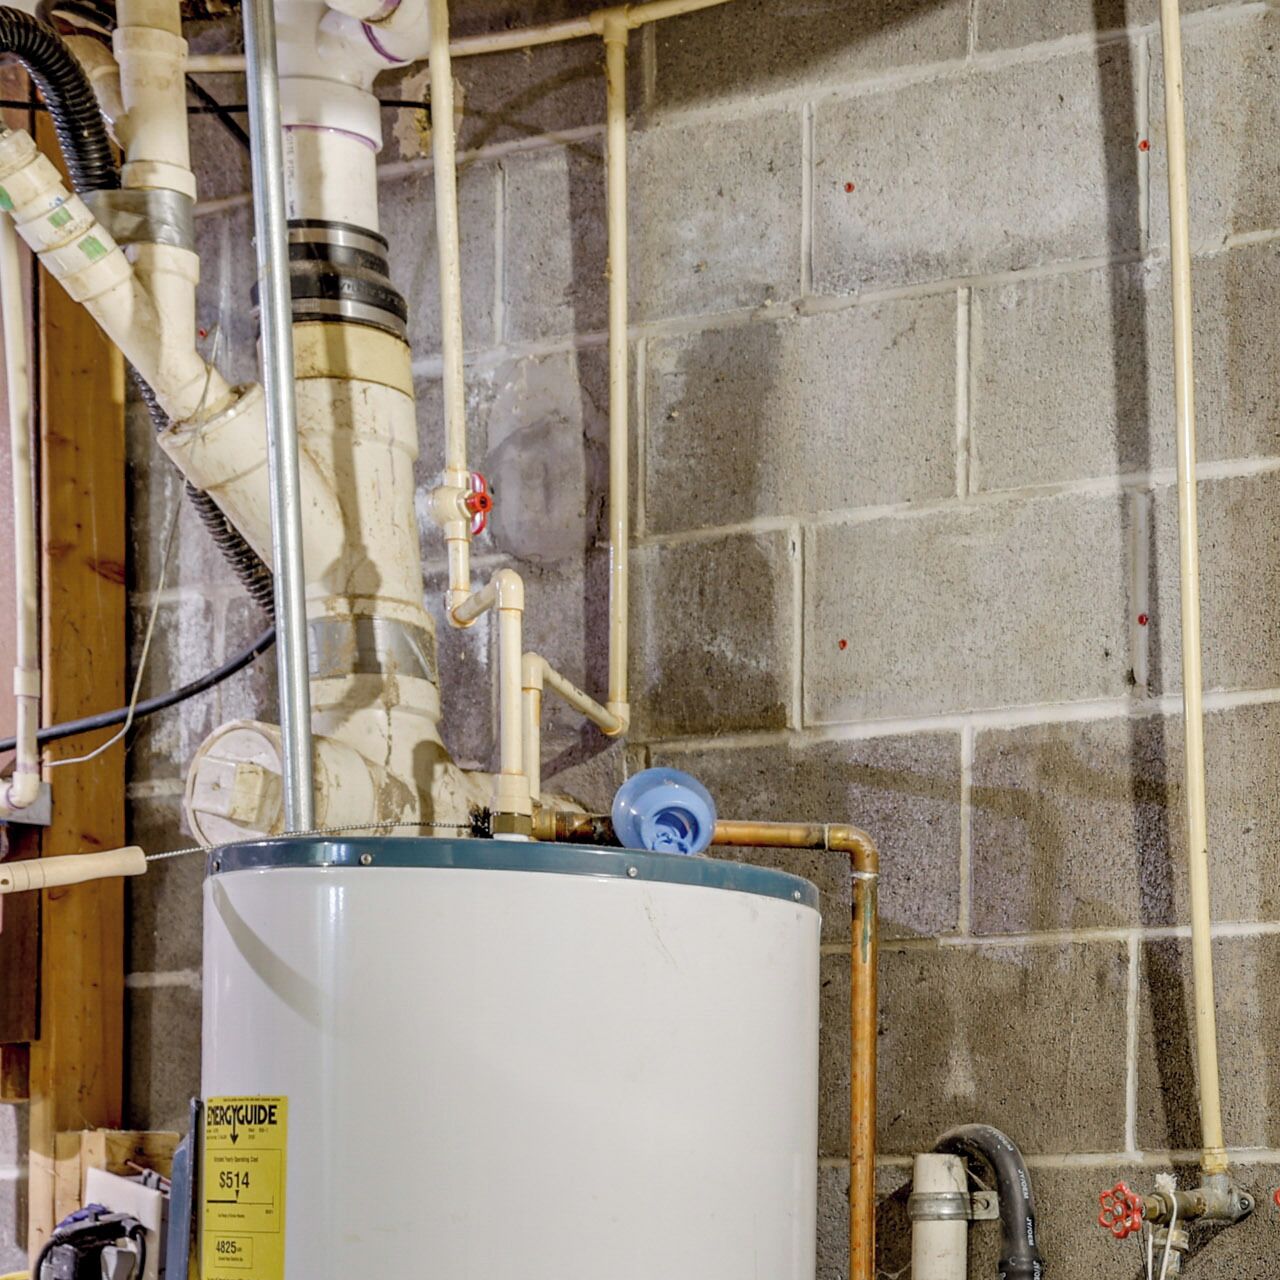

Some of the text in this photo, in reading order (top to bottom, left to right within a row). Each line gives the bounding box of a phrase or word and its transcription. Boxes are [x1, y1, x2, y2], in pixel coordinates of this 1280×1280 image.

[207, 1104, 277, 1126] ENERGYGUIDE
[219, 1171, 250, 1189] $514
[216, 1241, 237, 1254] 4825
